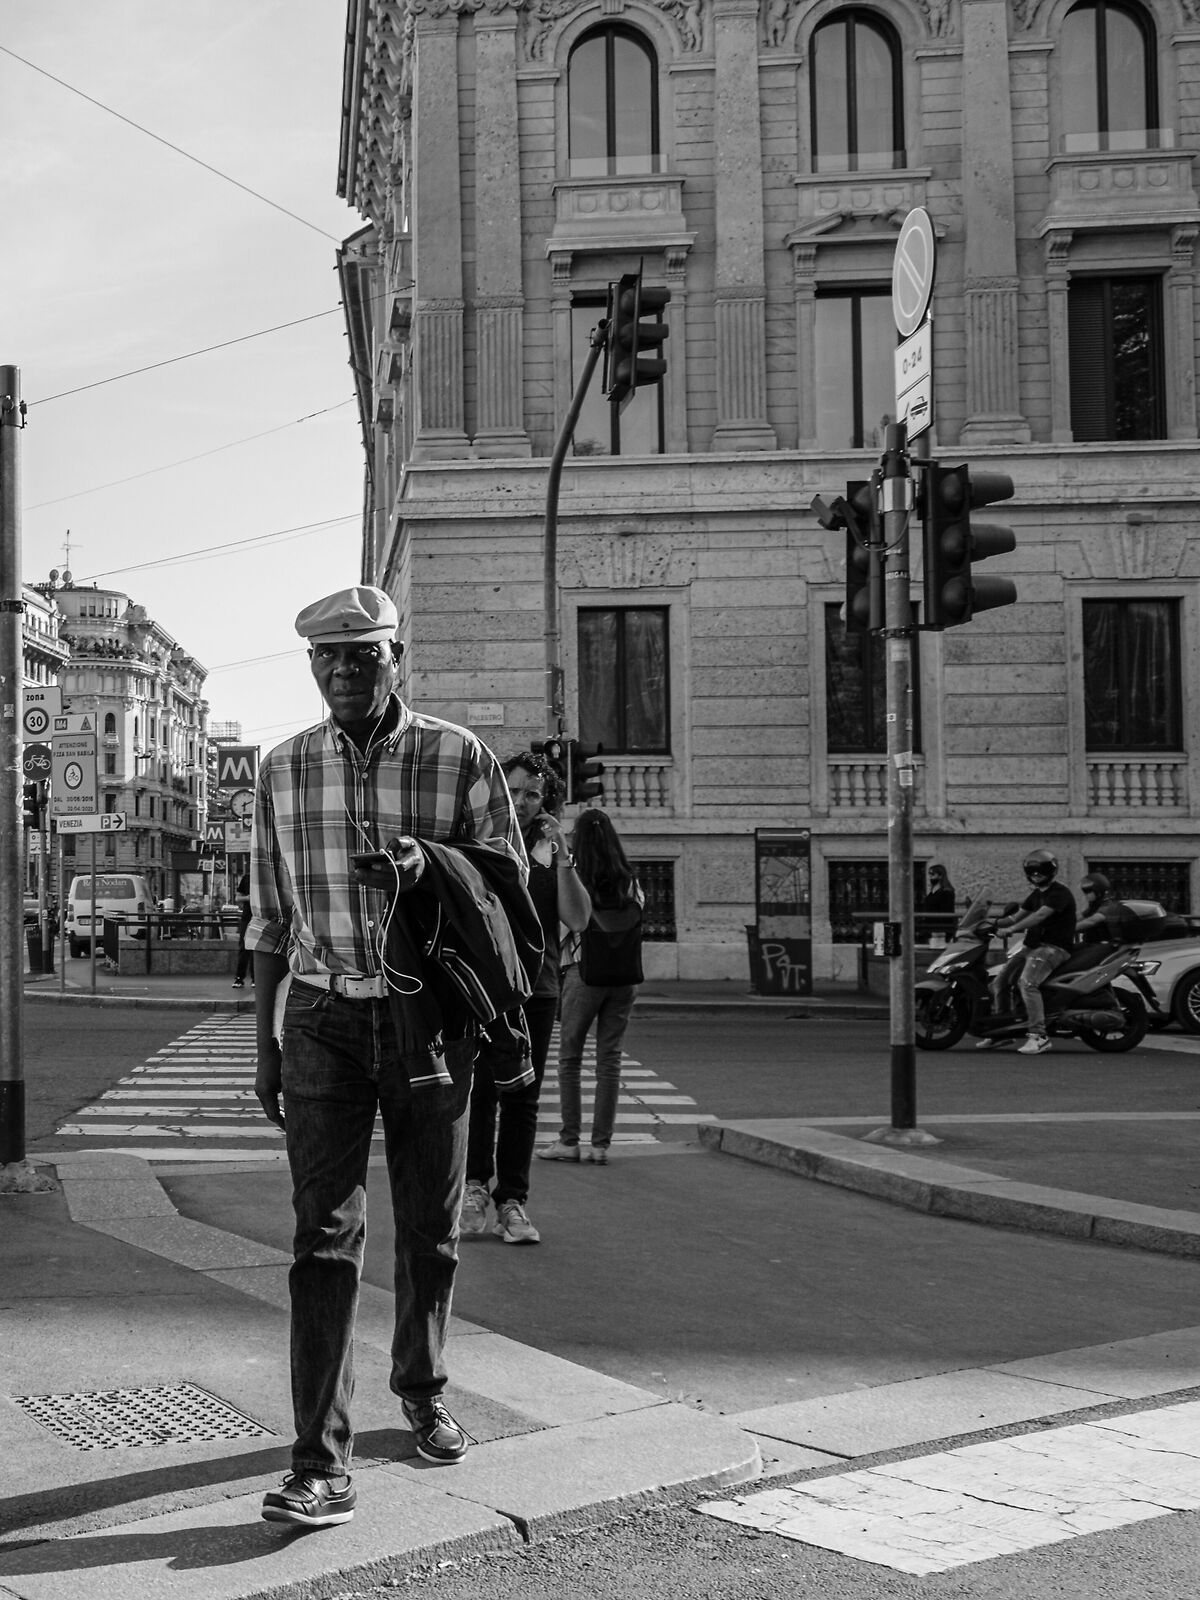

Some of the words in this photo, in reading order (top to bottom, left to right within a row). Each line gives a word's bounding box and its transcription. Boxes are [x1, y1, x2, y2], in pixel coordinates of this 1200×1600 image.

[902, 346, 922, 375] 0-24
[29, 716, 43, 728] 30
[220, 757, 253, 780] M
[59, 819, 83, 828] VENEZIA
[207, 827, 224, 839] M
